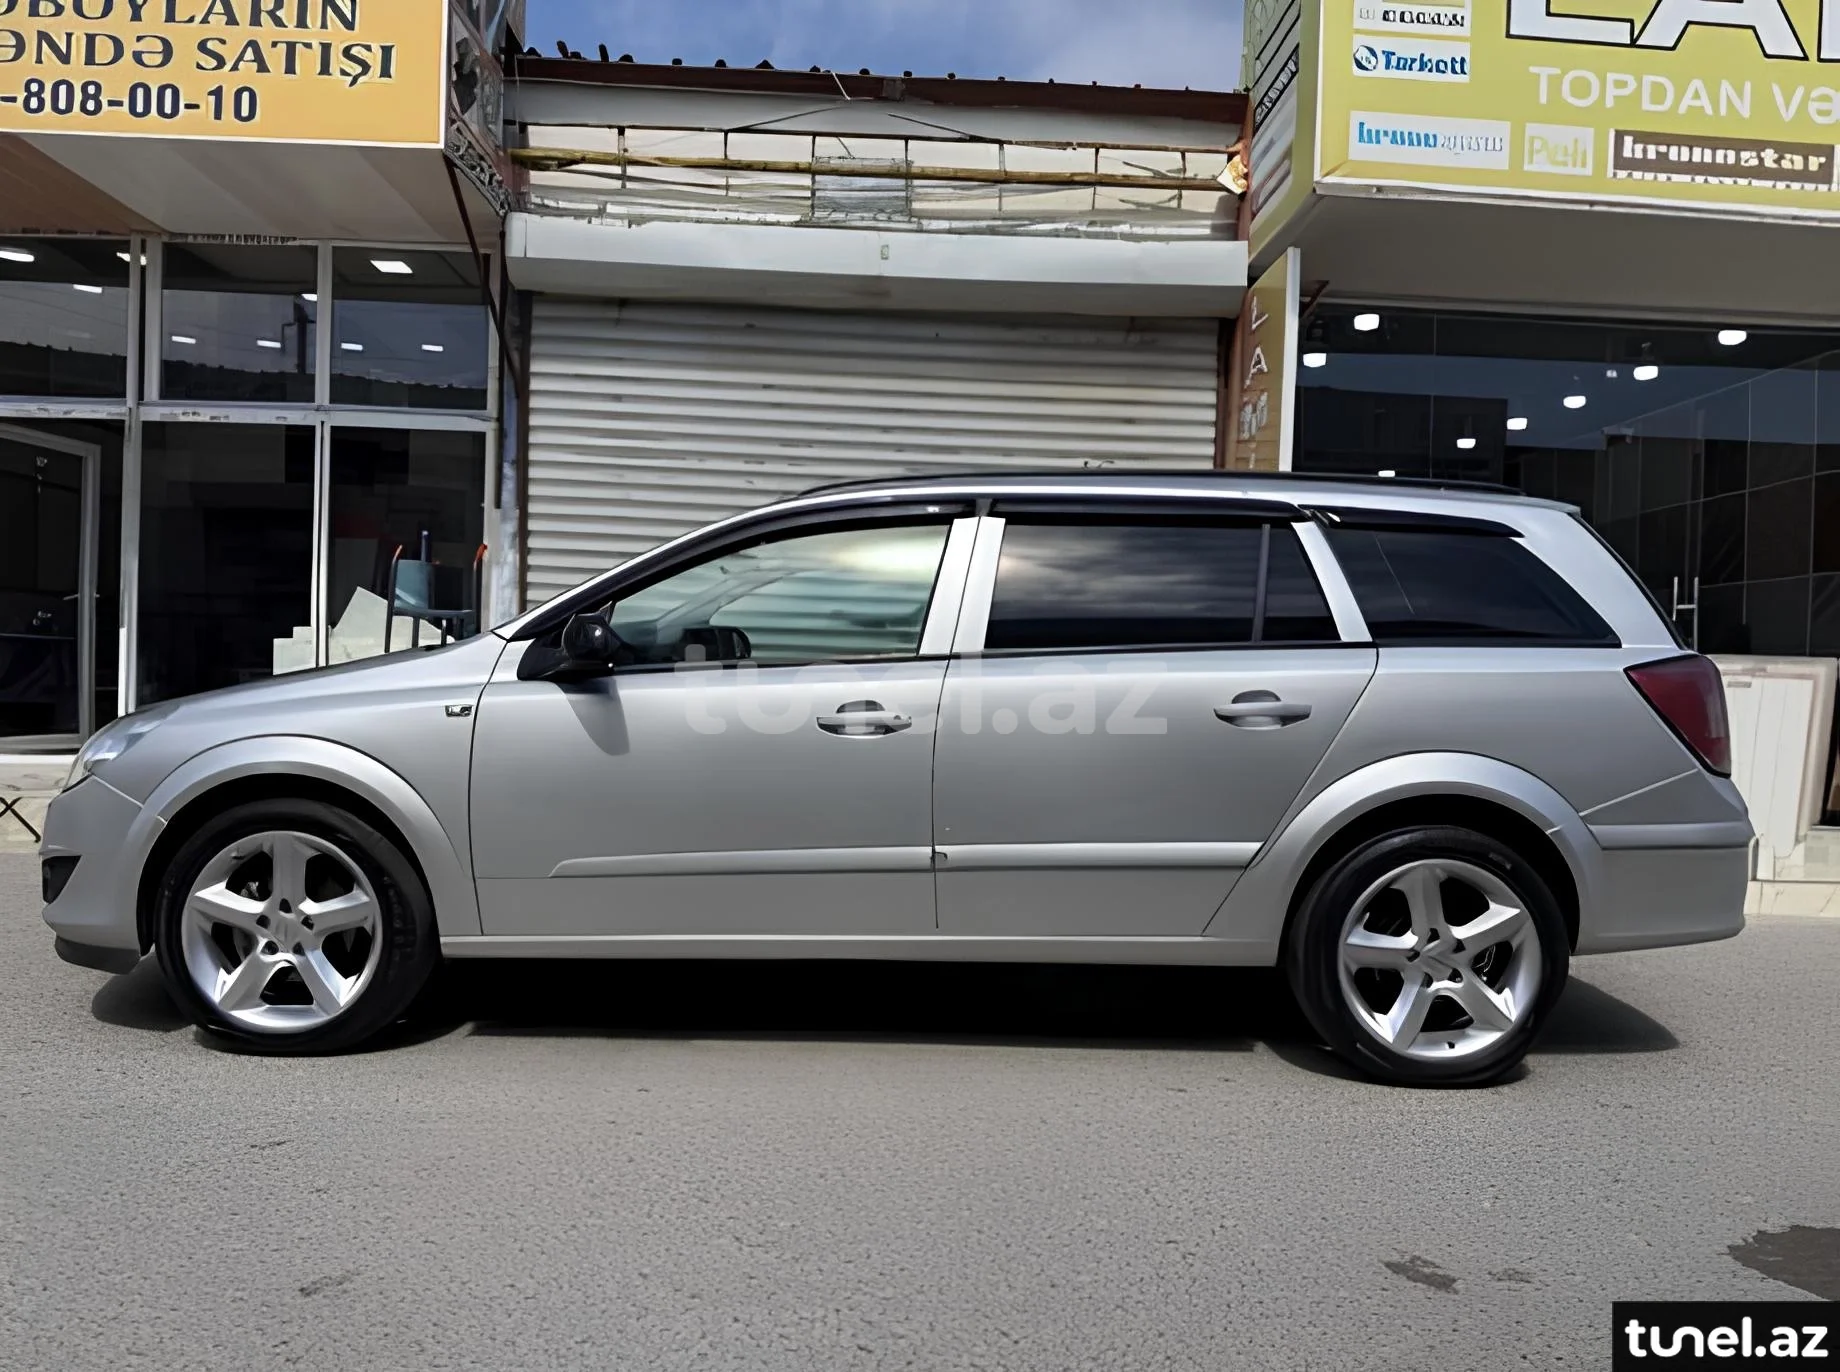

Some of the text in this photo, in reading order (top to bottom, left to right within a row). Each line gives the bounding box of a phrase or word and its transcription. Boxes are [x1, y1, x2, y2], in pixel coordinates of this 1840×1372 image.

[196, 37, 395, 87] SATIŞI
[1529, 66, 1840, 124] TOPDAN VƏ
